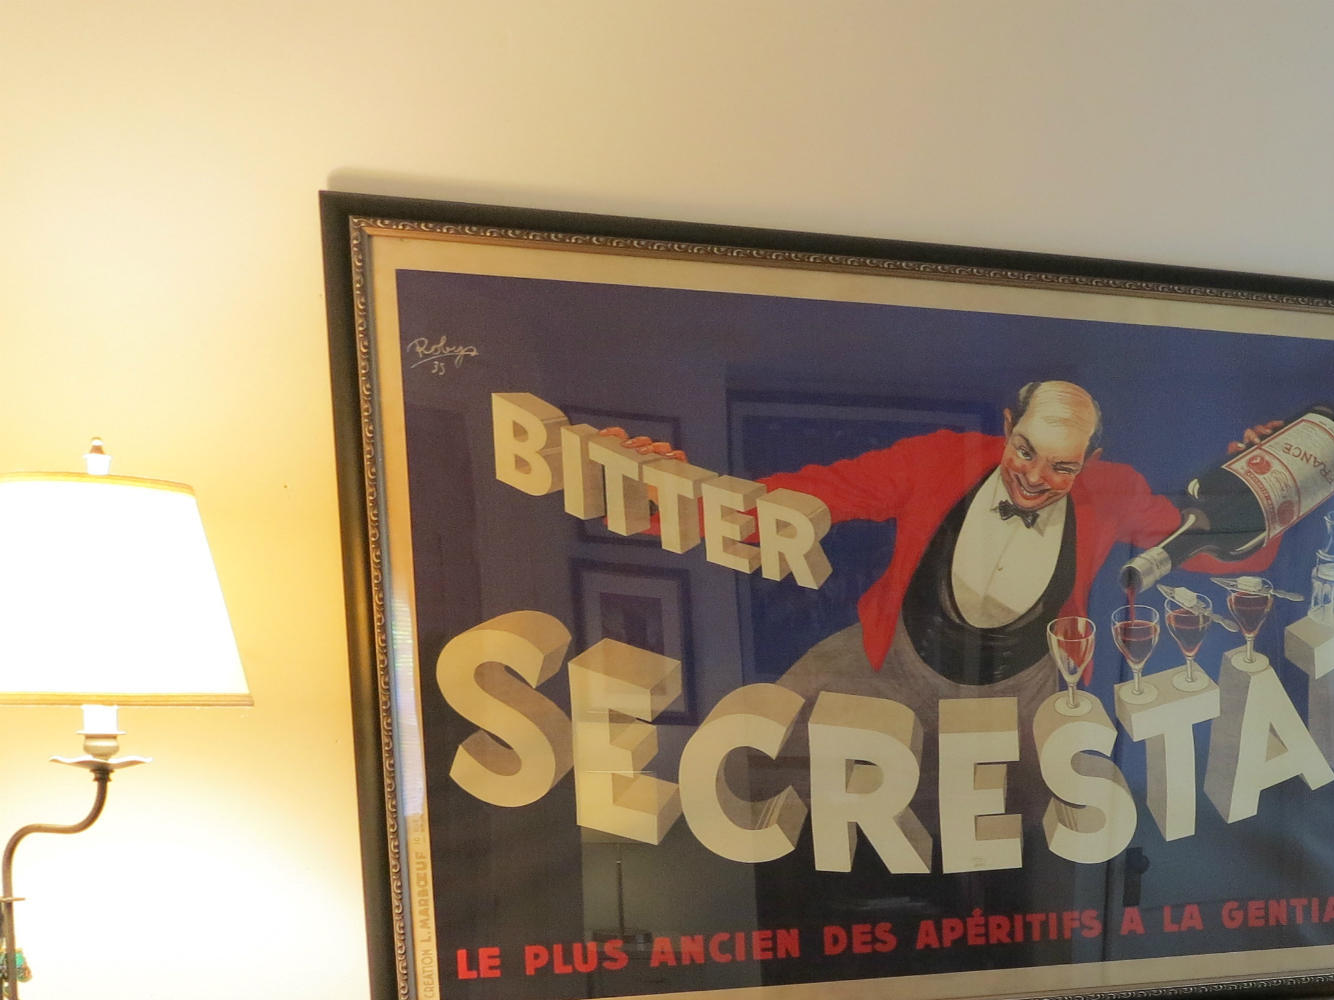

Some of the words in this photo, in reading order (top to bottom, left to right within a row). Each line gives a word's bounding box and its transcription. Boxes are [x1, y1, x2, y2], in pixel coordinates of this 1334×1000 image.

[492, 392, 832, 590] BITTER
[457, 947, 501, 979] LE
[524, 939, 629, 976] PLUS
[650, 928, 801, 968] ANCIEN
[823, 922, 898, 956] DES
[916, 908, 1101, 949] APÉRITIFS
[1120, 905, 1146, 936] A
[1162, 903, 1204, 933] LA
